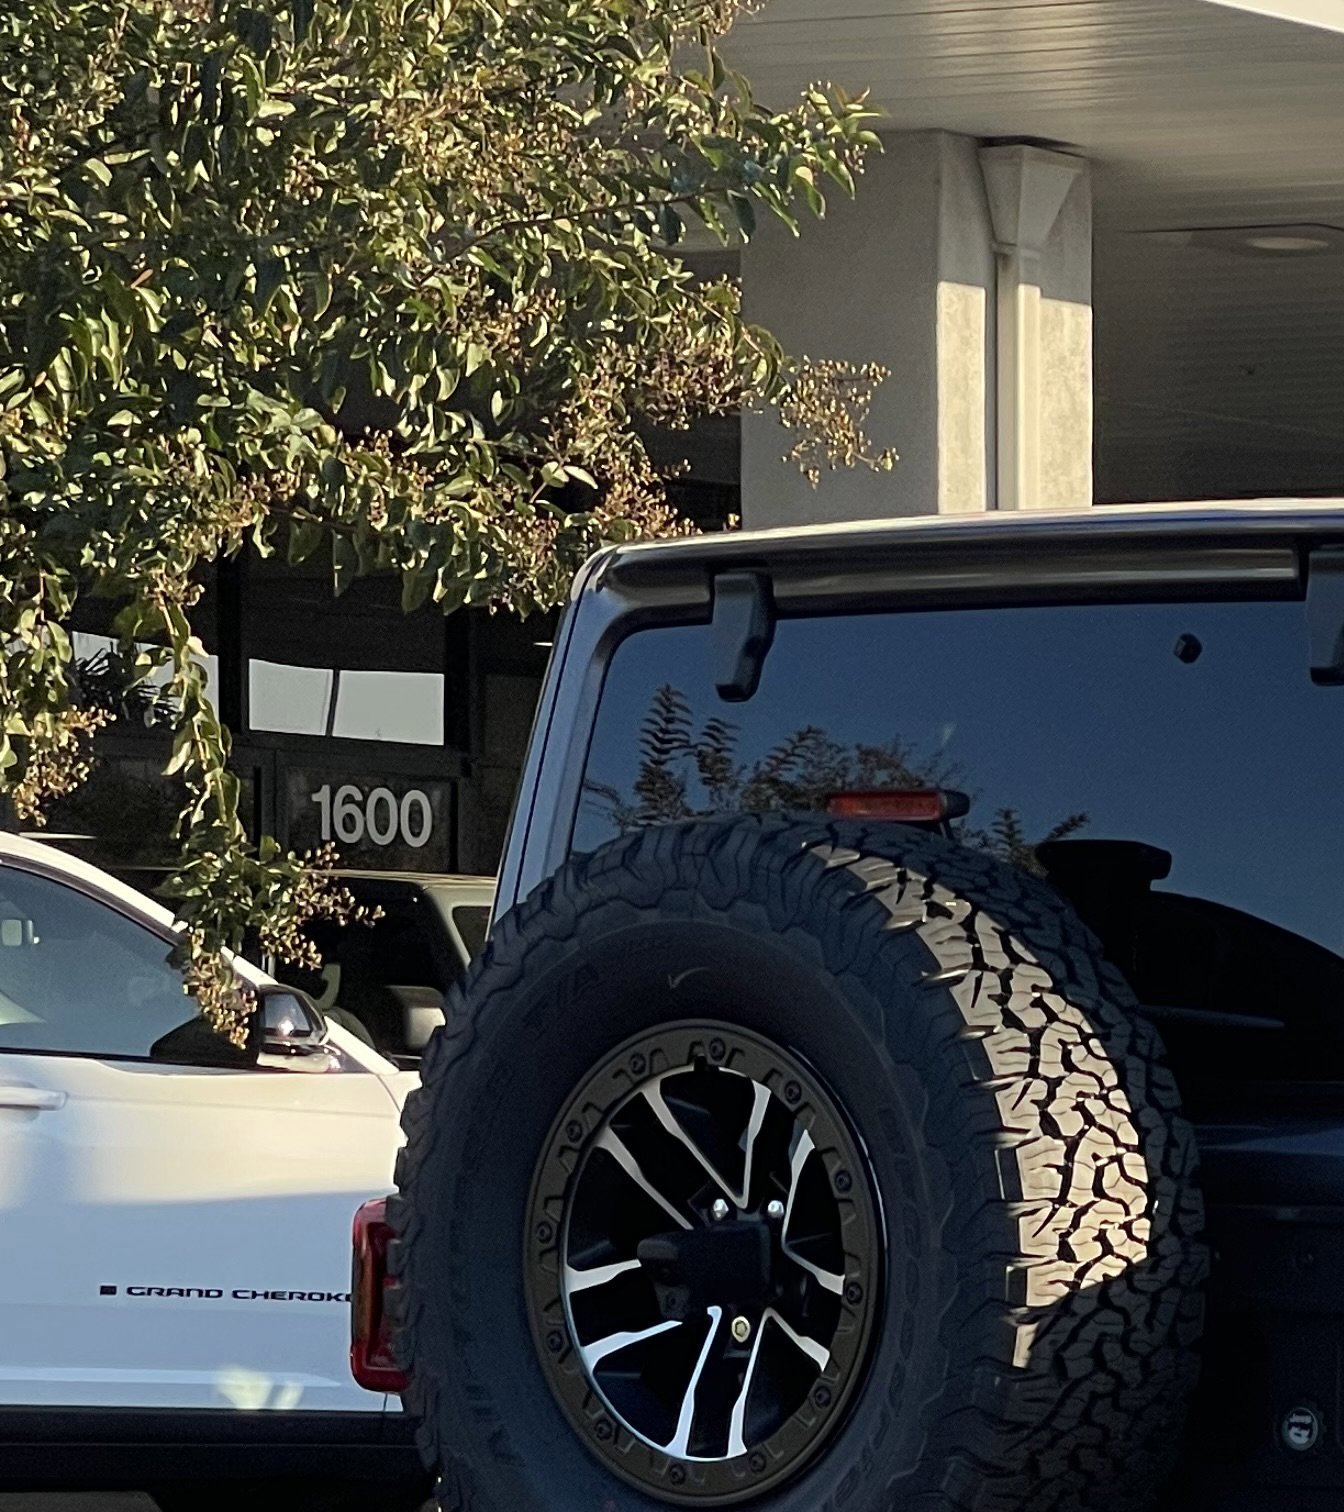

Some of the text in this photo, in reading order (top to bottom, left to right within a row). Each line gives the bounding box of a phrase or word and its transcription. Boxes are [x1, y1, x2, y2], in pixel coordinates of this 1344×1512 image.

[311, 784, 433, 848] 1600
[126, 1286, 351, 1303] GRAND CHEROK
